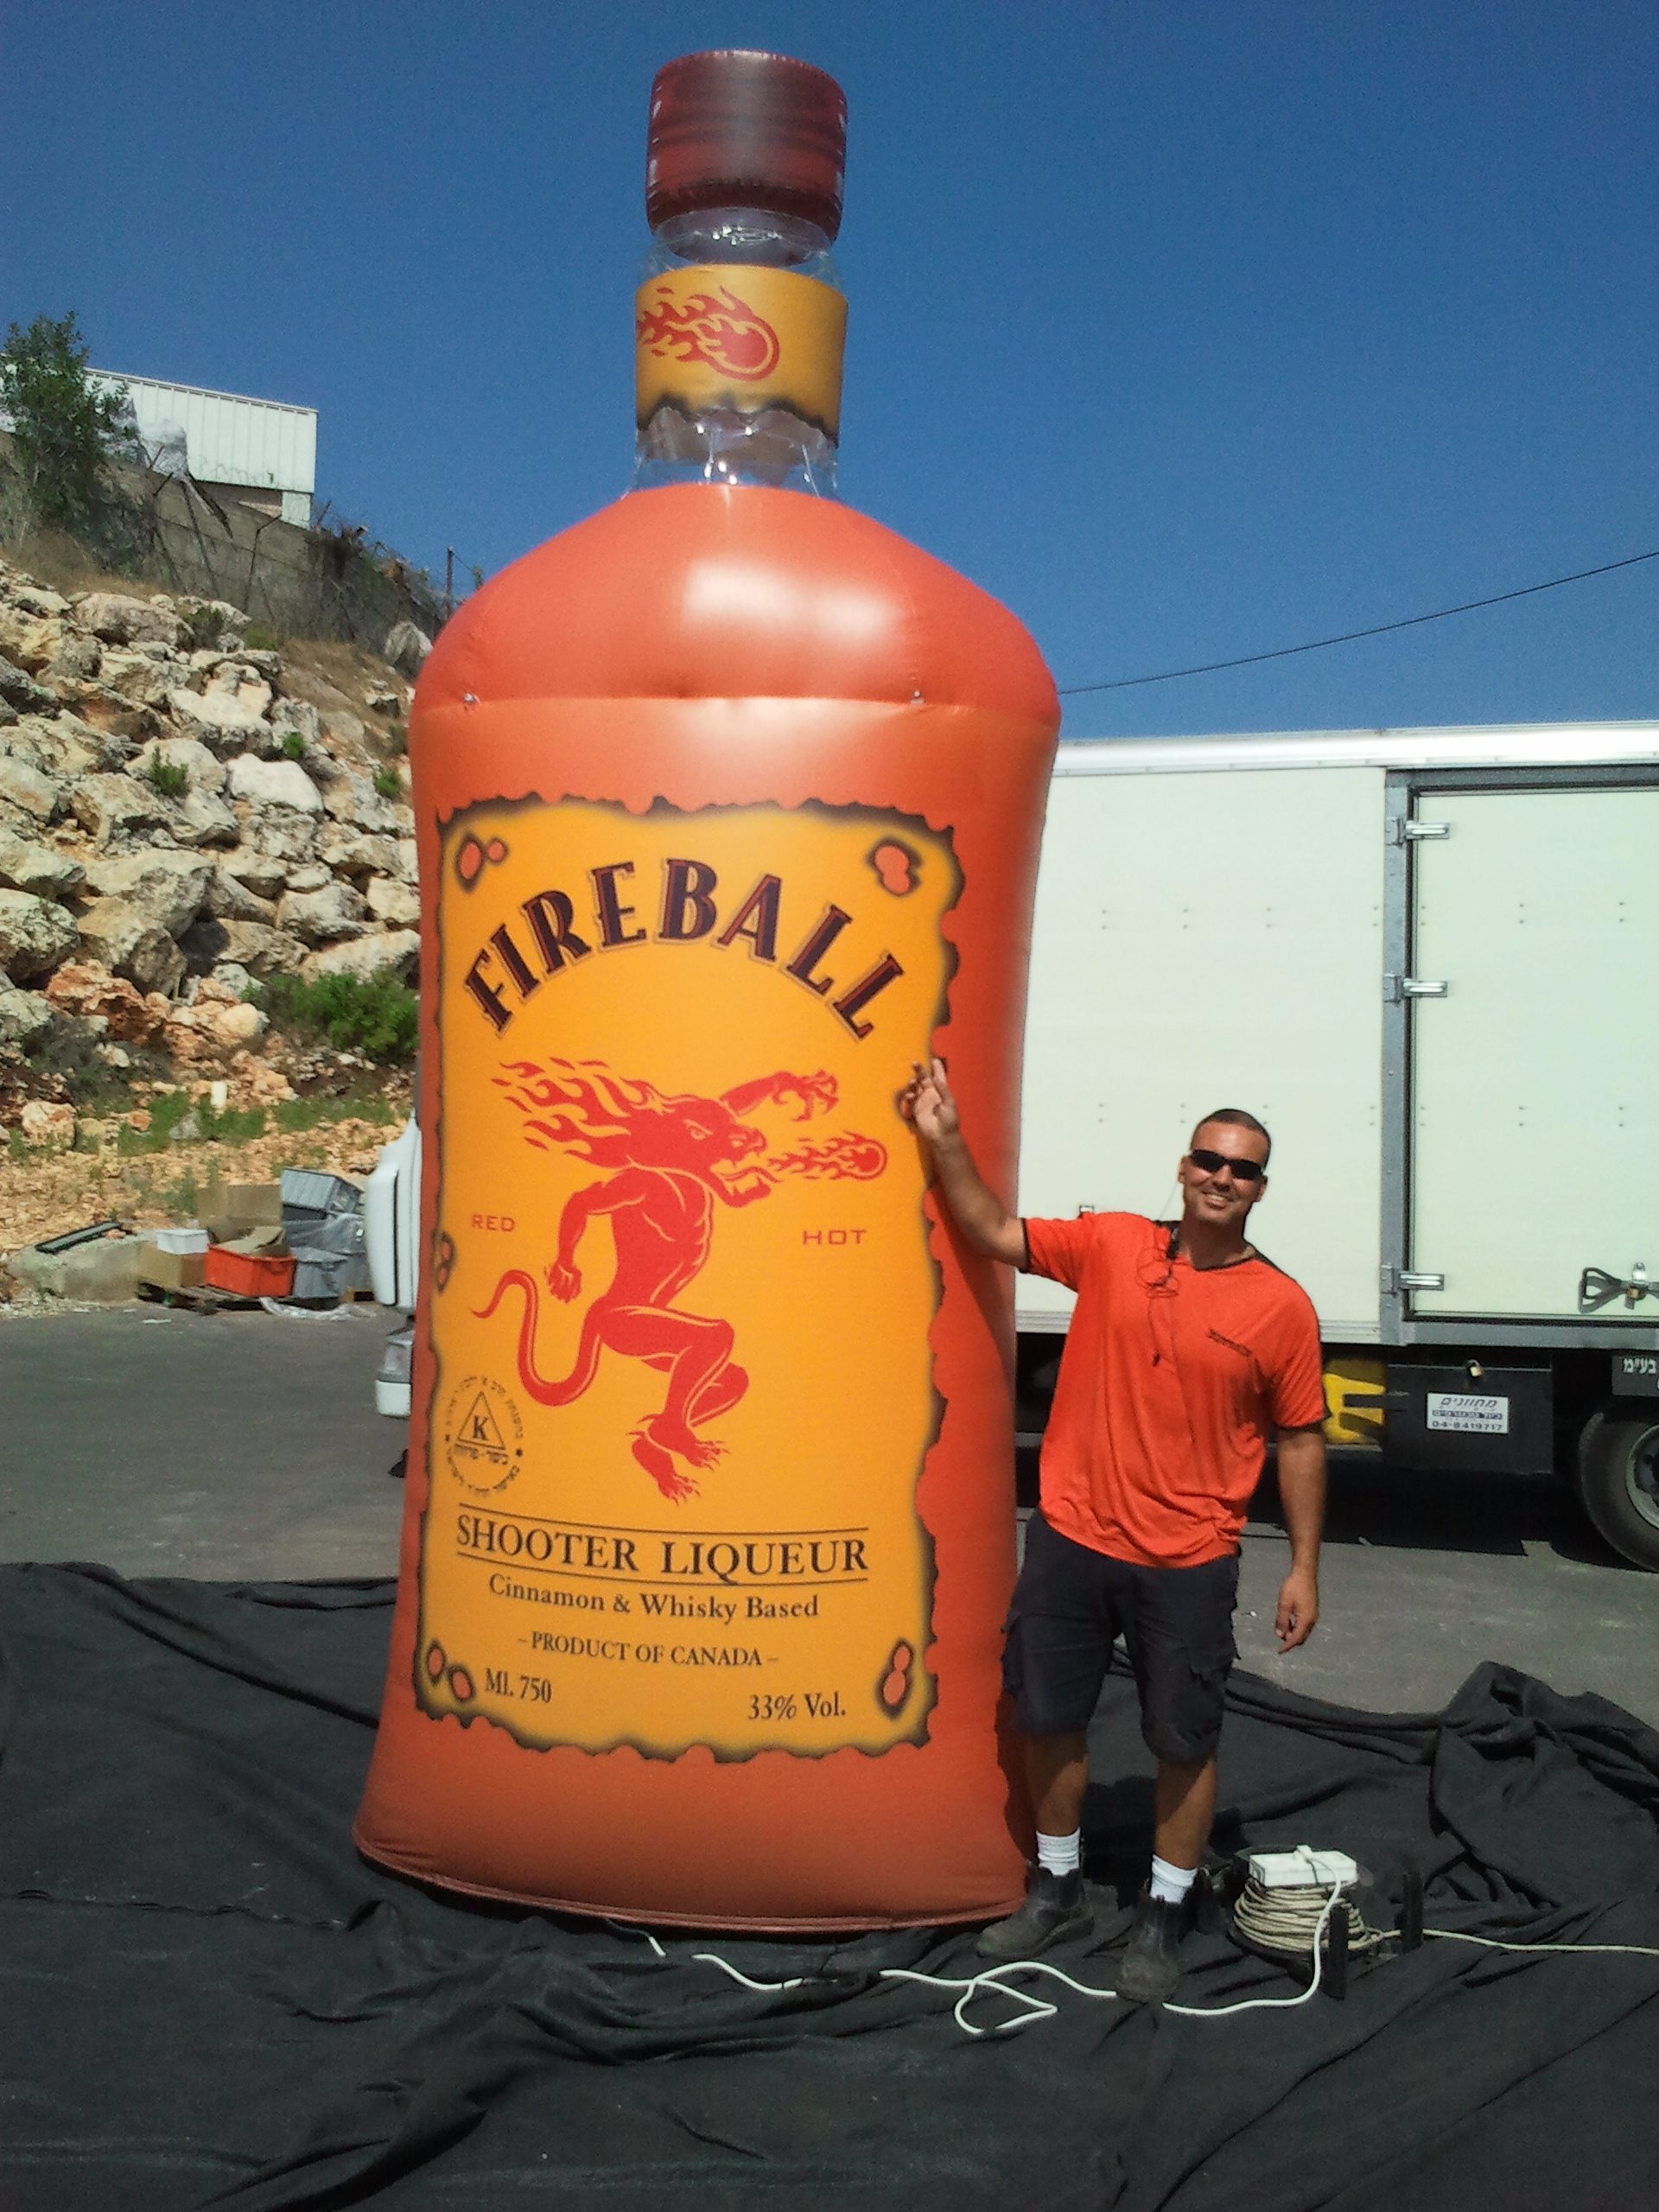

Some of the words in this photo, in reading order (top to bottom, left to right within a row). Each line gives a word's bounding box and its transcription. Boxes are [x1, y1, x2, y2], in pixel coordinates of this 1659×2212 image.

[464, 857, 905, 1039] FIREBALL
[472, 1214, 516, 1232] RED
[802, 1229, 868, 1245] HOT
[472, 1414, 489, 1441] K
[456, 1514, 639, 1572] SHOOTER
[660, 1539, 868, 1586] LIQUEUR
[488, 1573, 605, 1611] Cinnamon
[613, 1593, 631, 1613] &
[639, 1592, 737, 1625] Whisky
[746, 1593, 819, 1618] Based
[635, 1643, 664, 1663] OF
[519, 1675, 553, 1704] 750
[747, 1694, 797, 1720] 33%
[804, 1691, 847, 1719] Vol.
